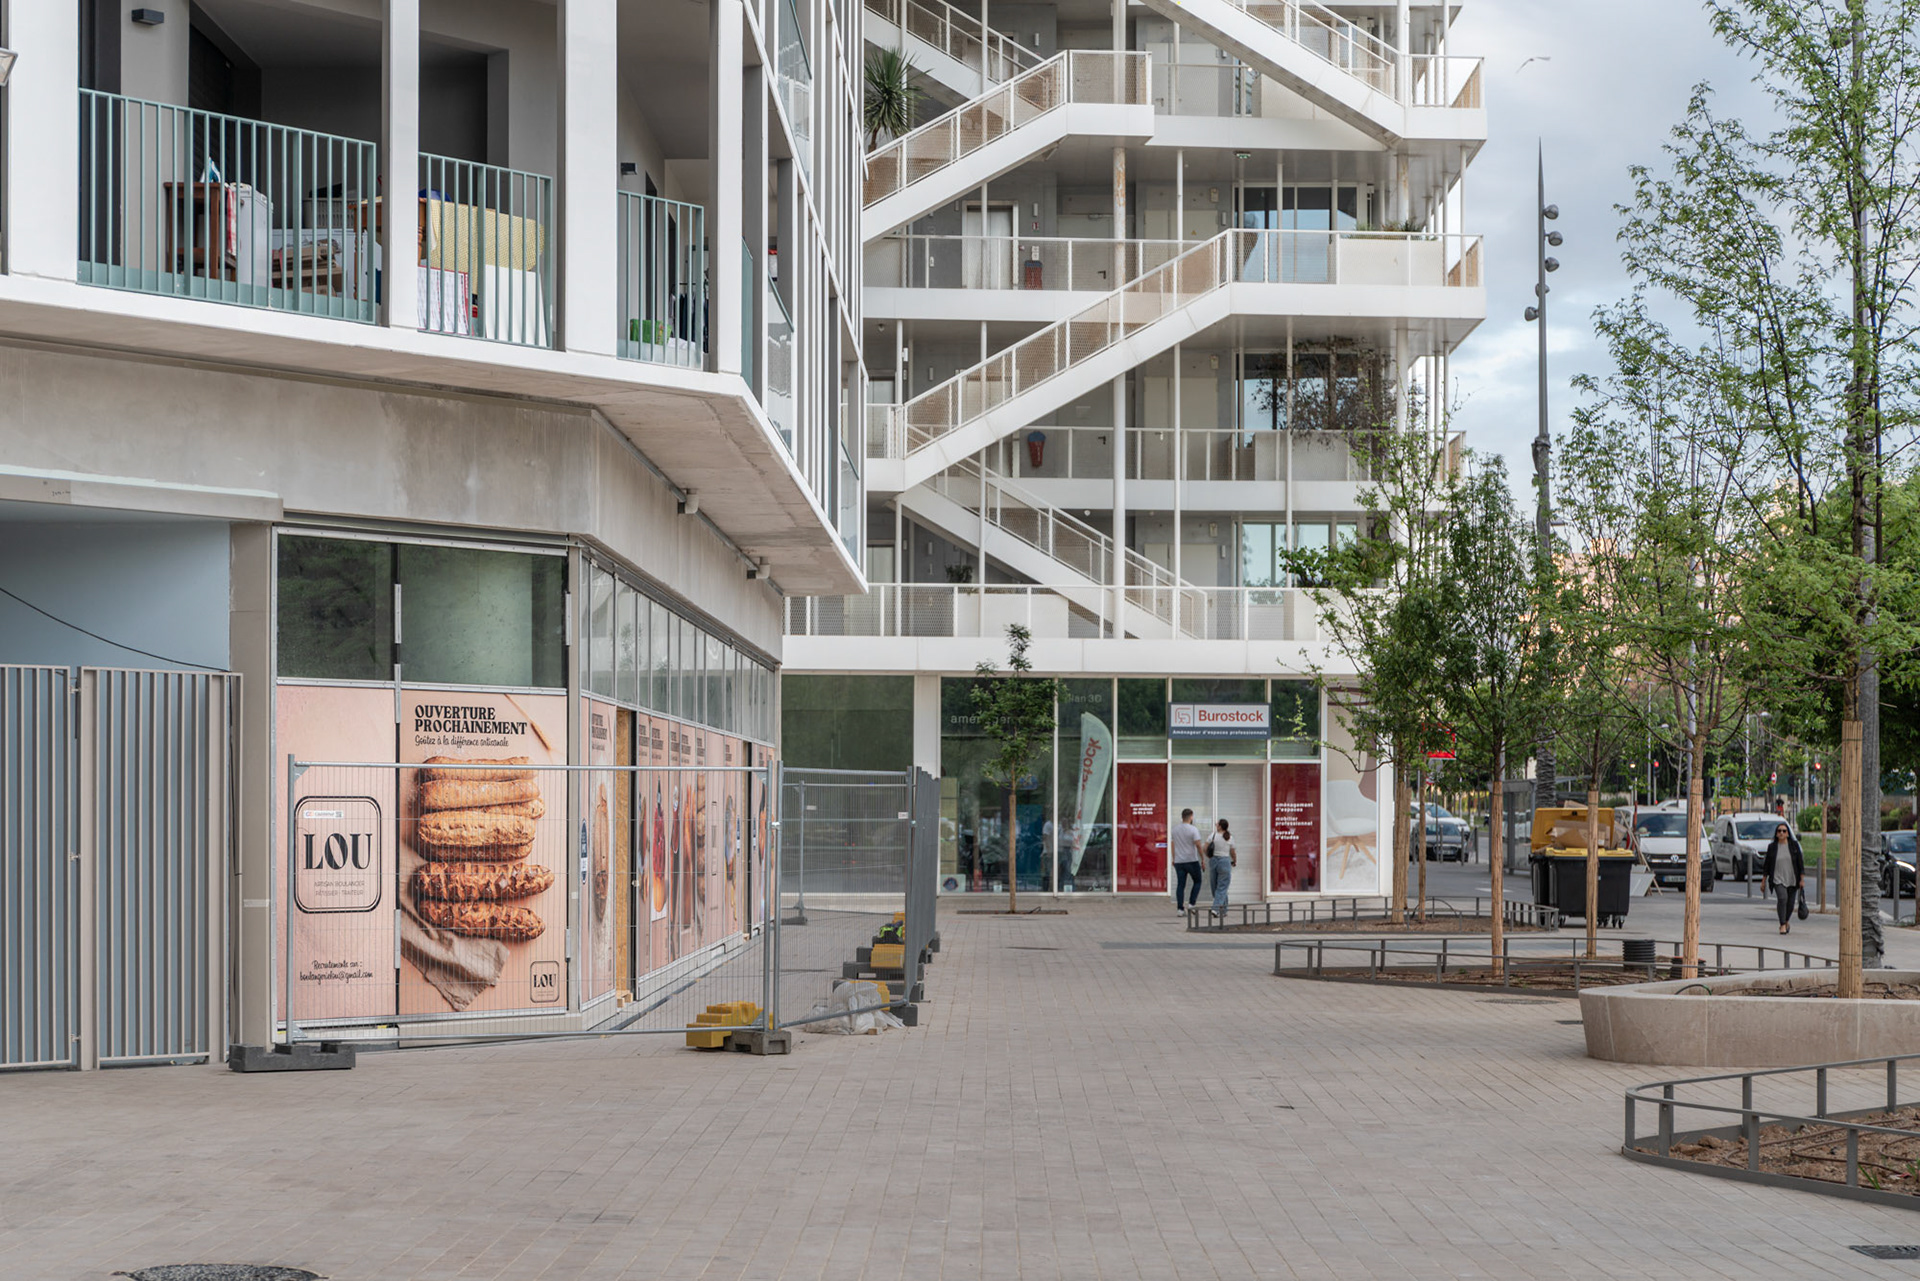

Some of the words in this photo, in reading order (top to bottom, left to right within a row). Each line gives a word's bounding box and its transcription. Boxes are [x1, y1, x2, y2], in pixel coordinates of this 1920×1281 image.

[414, 704, 496, 720] OUVERTURE
[1198, 709, 1264, 722] Burostock
[414, 719, 528, 735] PROCHAINEMENT
[414, 735, 435, 746] Goûtez
[437, 735, 442, 746] à
[442, 734, 450, 746] la
[450, 735, 480, 749] différence
[480, 737, 509, 747] artisanale
[303, 833, 373, 870] LOU
[533, 974, 556, 987] LOU
